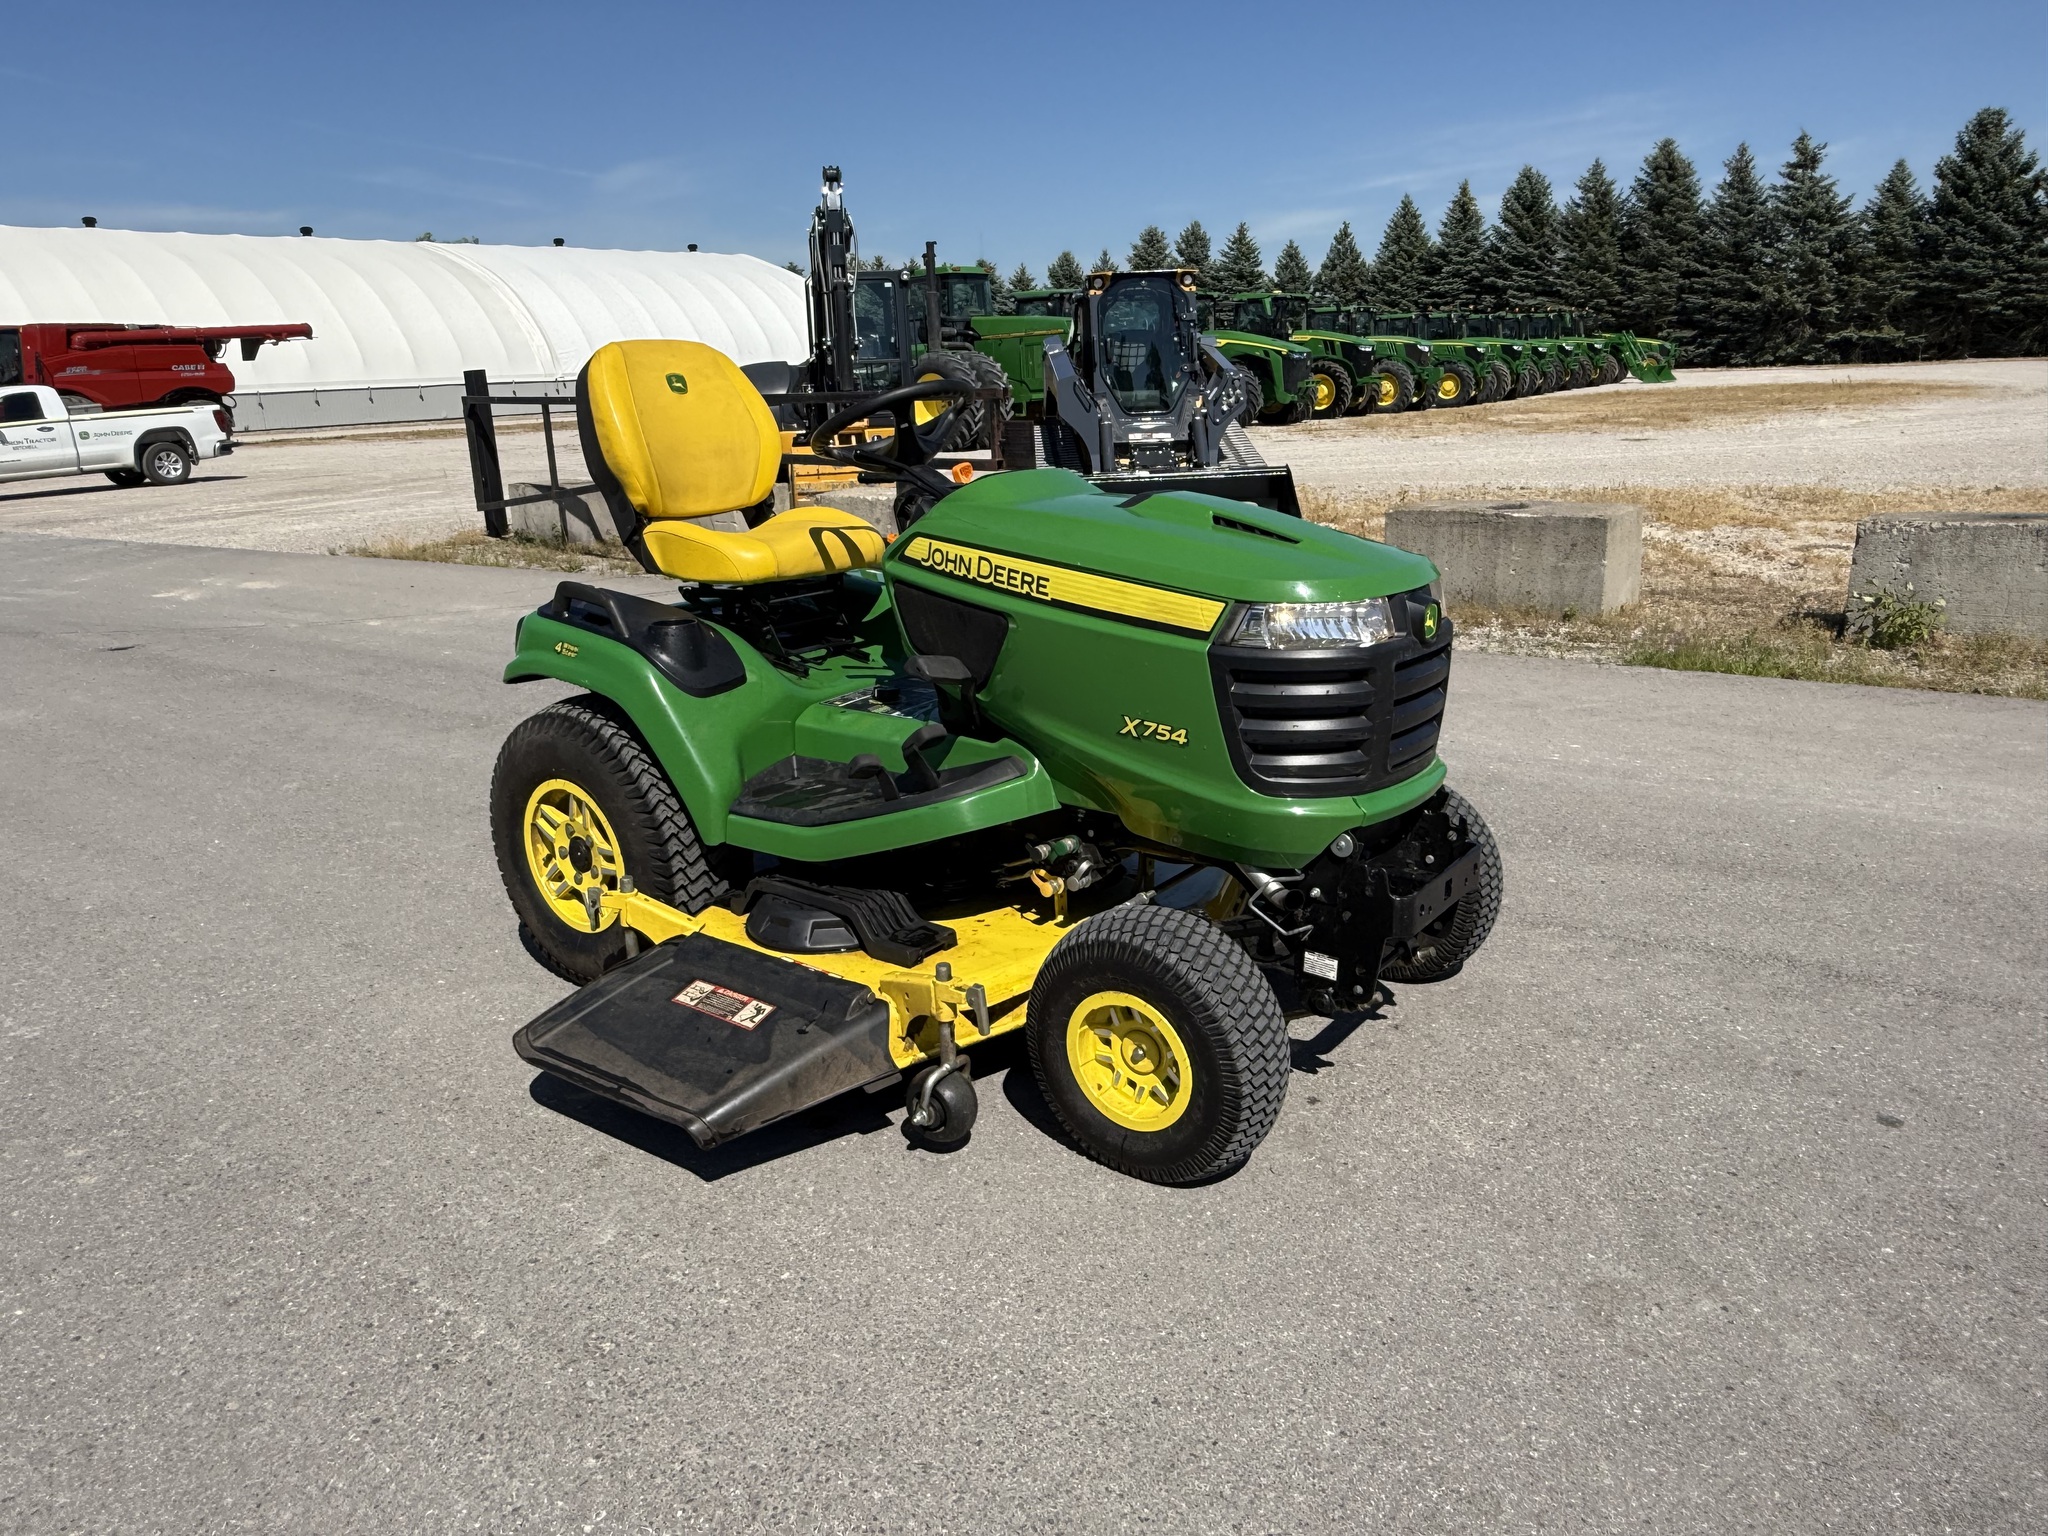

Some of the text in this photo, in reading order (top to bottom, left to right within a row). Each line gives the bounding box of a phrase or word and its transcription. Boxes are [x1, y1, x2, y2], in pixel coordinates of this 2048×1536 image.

[921, 542, 1051, 598] JOHN DEERE
[1119, 715, 1188, 745] X754
